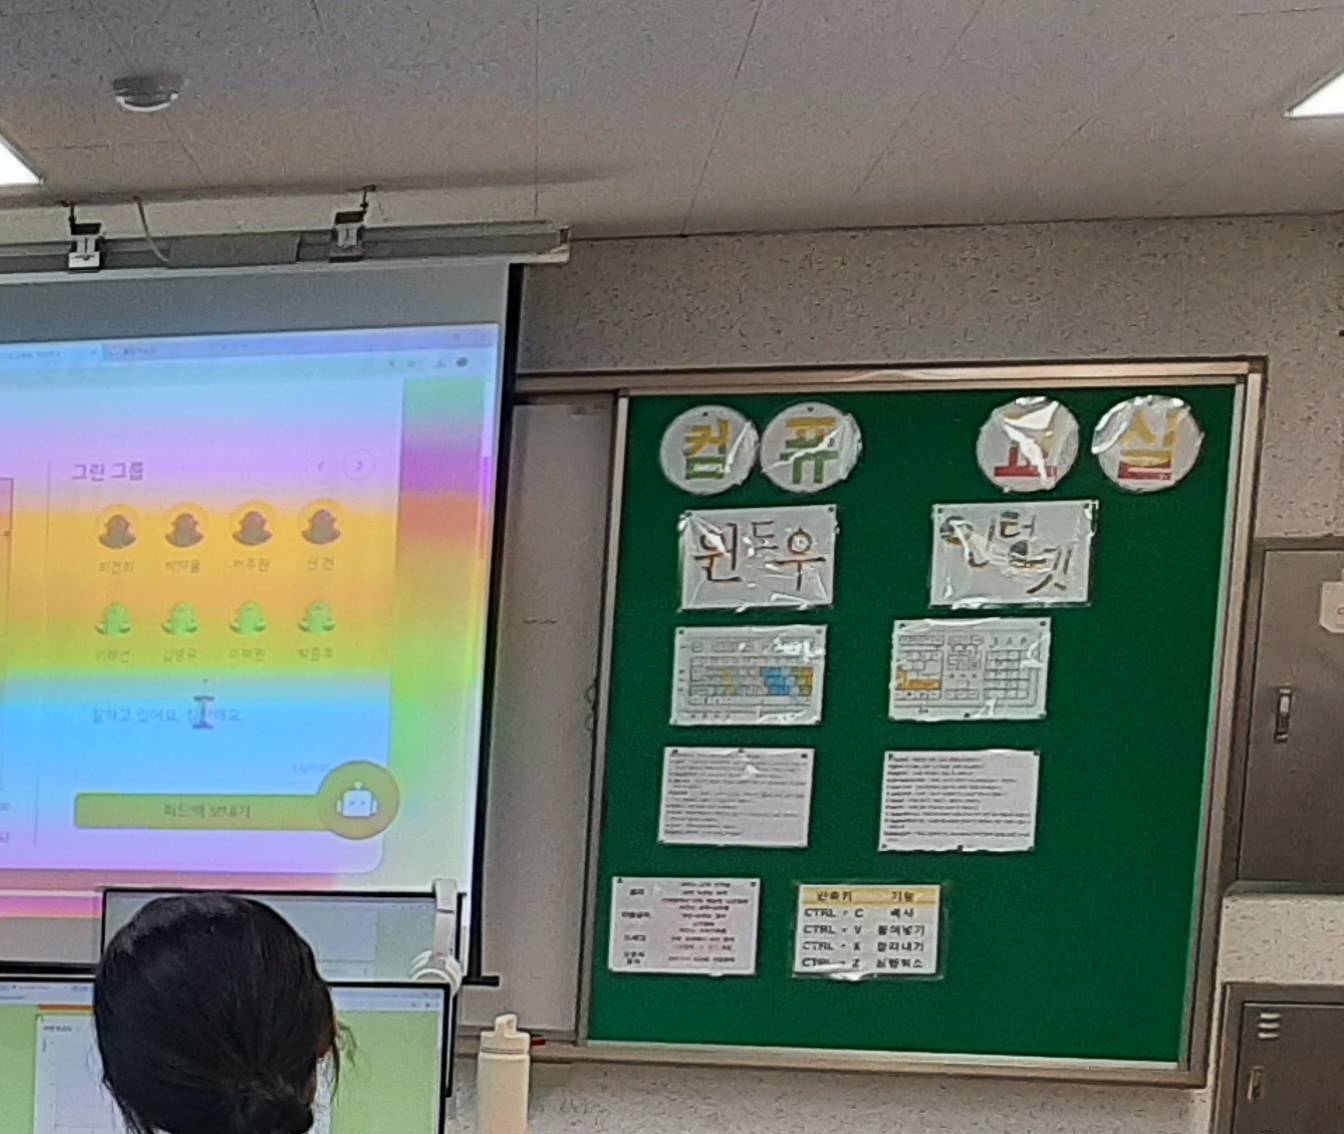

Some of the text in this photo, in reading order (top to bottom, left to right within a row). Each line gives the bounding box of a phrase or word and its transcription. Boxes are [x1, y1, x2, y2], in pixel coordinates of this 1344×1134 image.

[110, 461, 144, 482] 그룹
[693, 520, 826, 591] 윈도우
[804, 908, 836, 918] CTRL
[854, 908, 865, 918] C
[803, 925, 835, 935] CTRL
